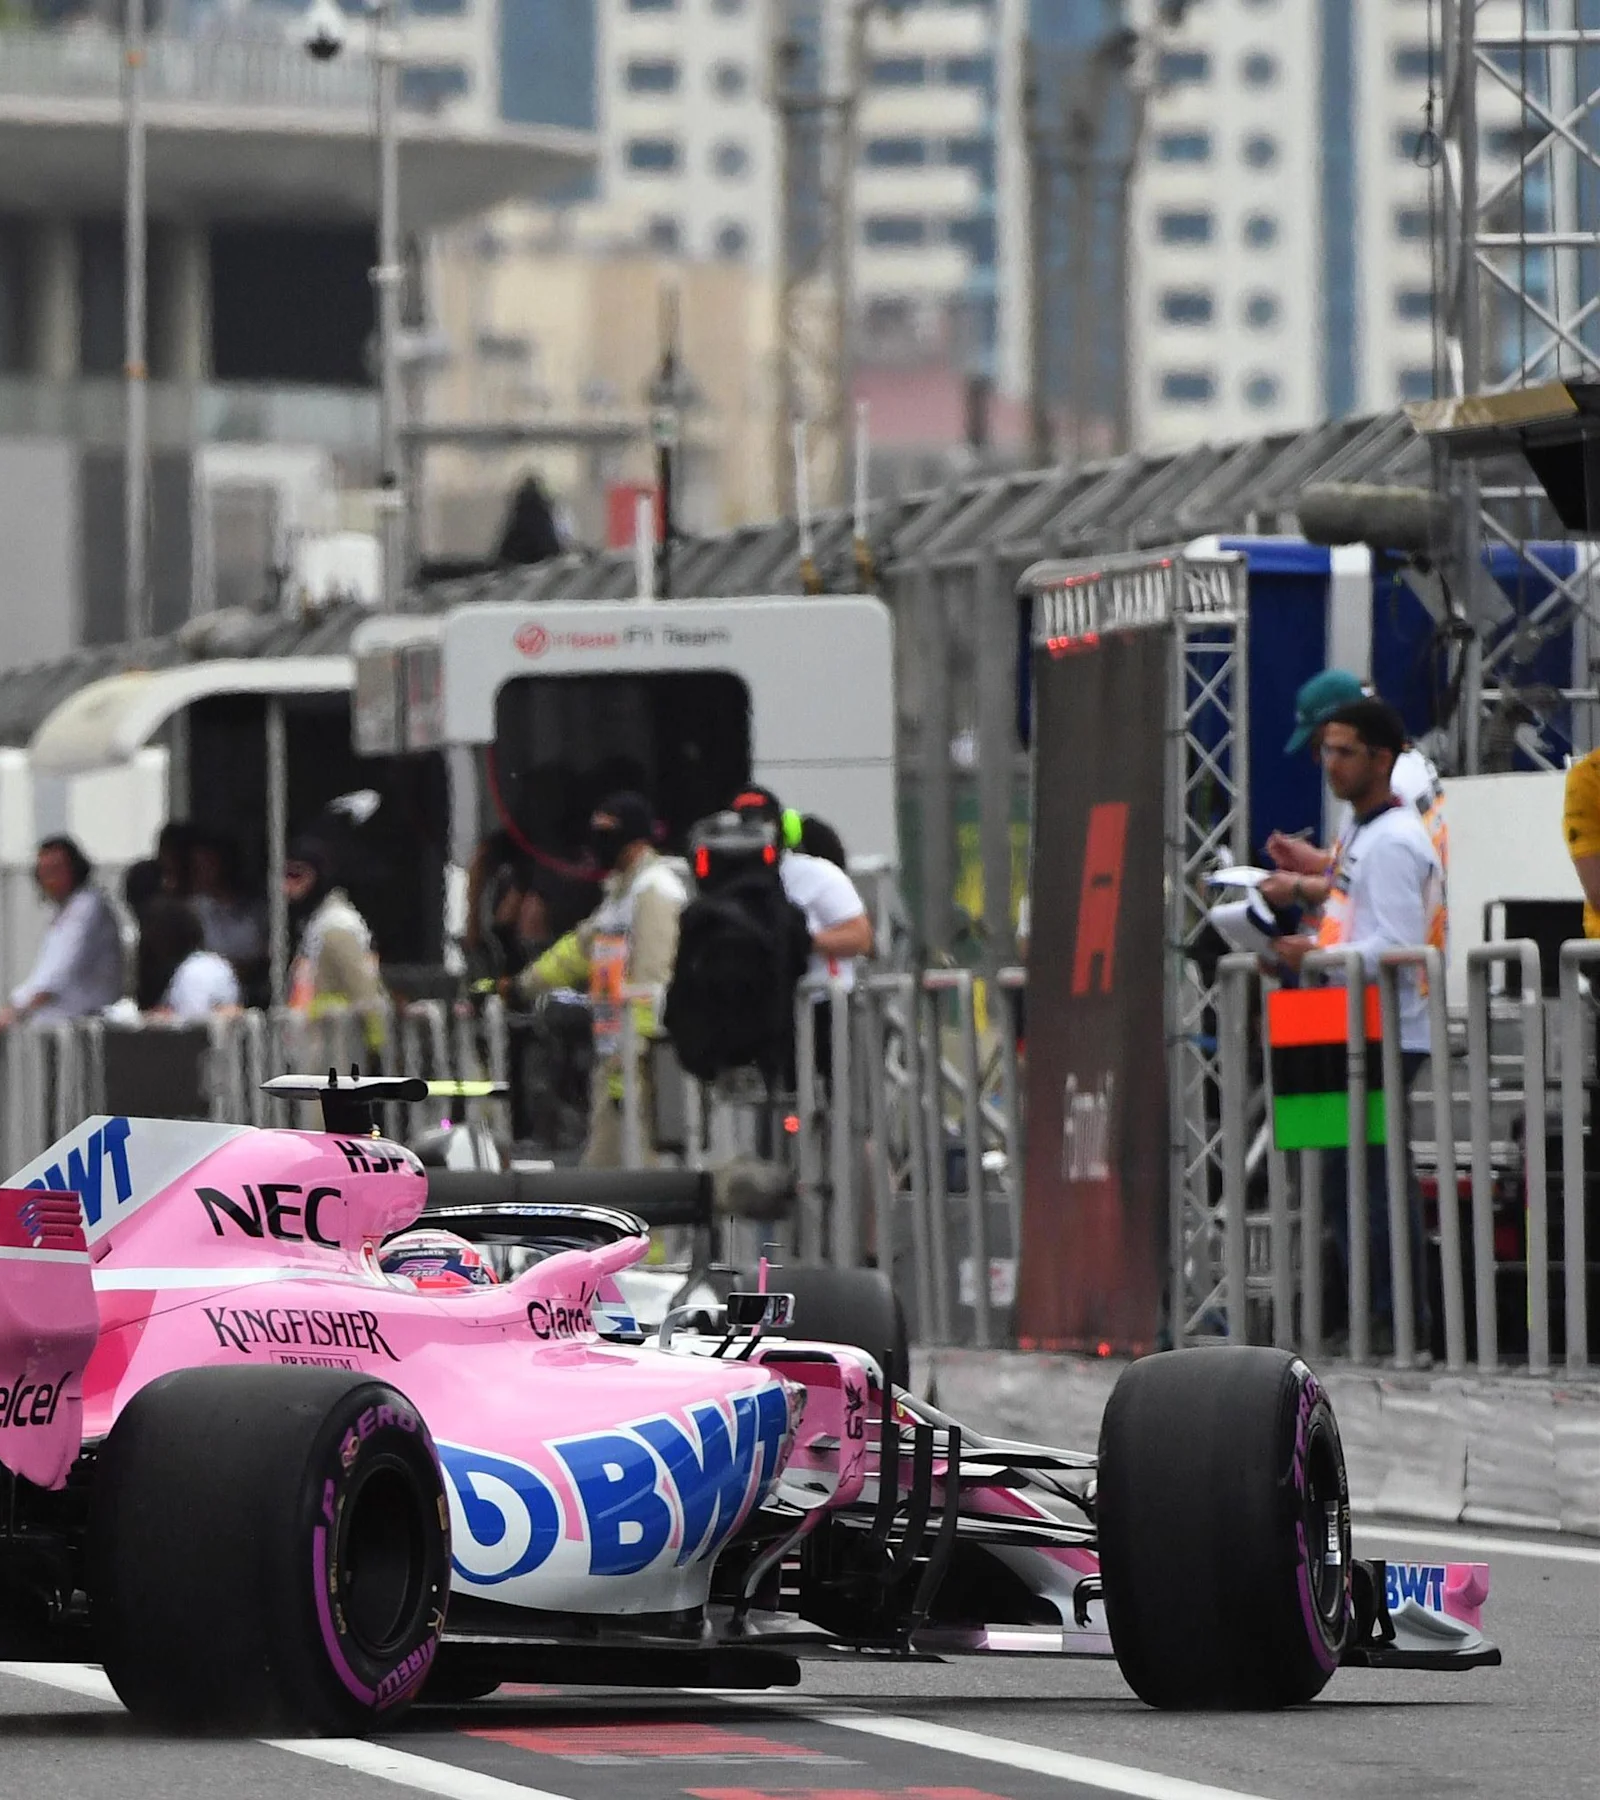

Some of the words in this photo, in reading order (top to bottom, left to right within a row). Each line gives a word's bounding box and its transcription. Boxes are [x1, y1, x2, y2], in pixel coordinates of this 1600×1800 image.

[23, 1116, 133, 1228] WT
[194, 1183, 342, 1248] NEC
[202, 1306, 402, 1362] KINGFISHER
[550, 1386, 789, 1577] BWT
[1386, 1565, 1445, 1612] BWT
